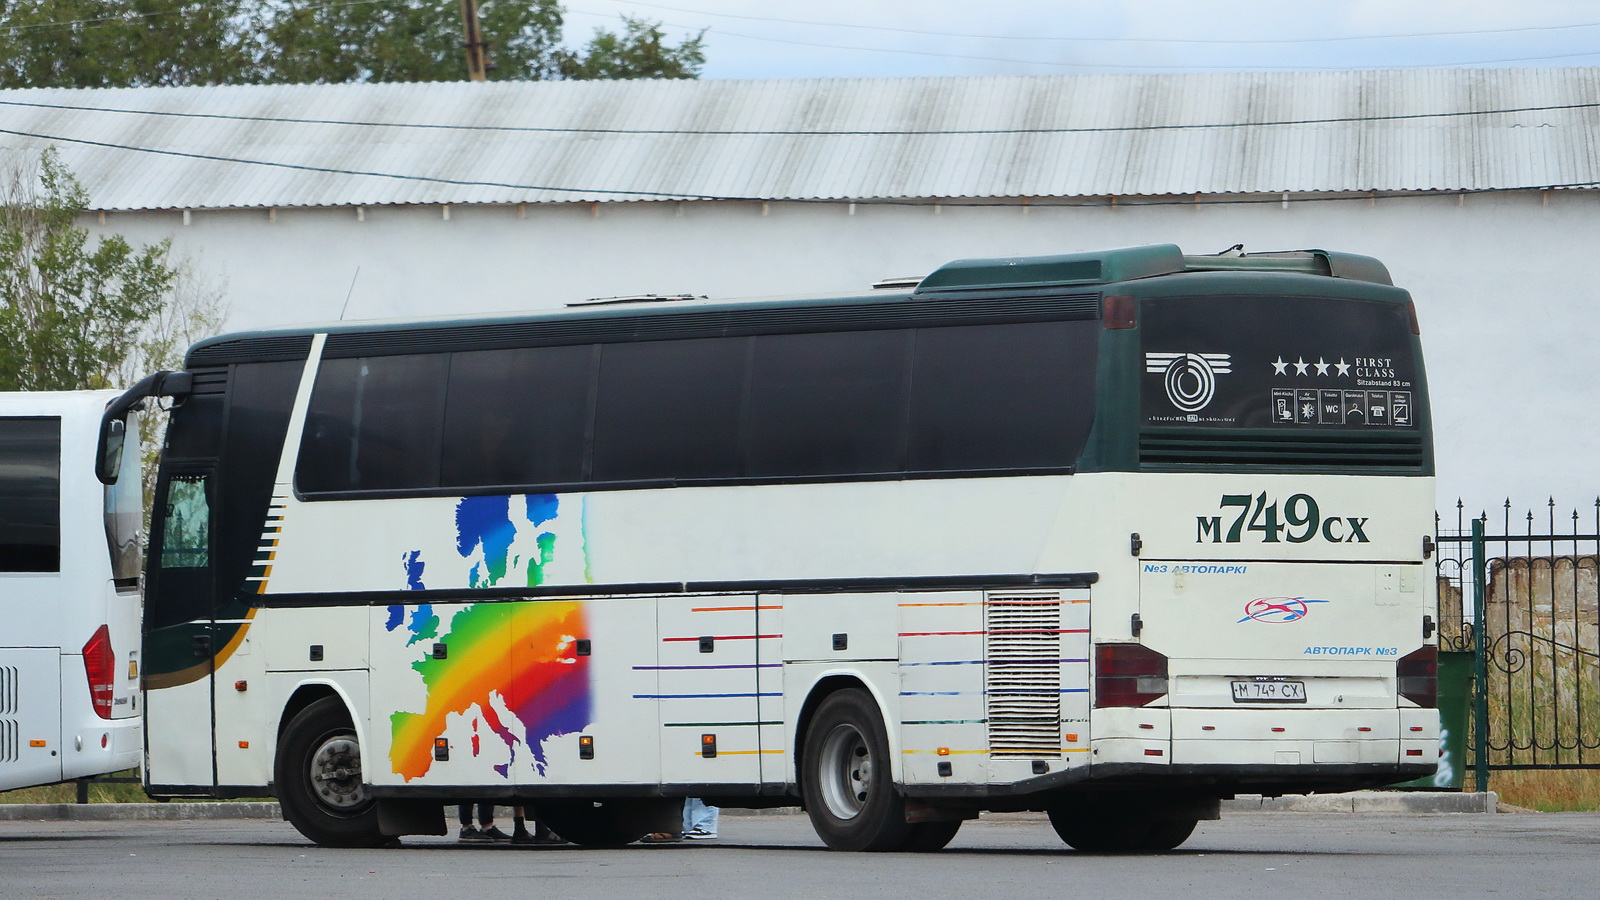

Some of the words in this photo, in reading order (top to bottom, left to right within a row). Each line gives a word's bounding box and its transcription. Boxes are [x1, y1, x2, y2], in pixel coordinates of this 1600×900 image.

[1355, 357, 1392, 368] FIRST
[1356, 367, 1395, 378] CLASS
[1357, 379, 1392, 387] Sitzabstand
[1325, 405, 1339, 413] WC
[1143, 565, 1168, 574] №3
[1303, 647, 1371, 656] АВТОПАРК
[1375, 647, 1398, 656] №3
